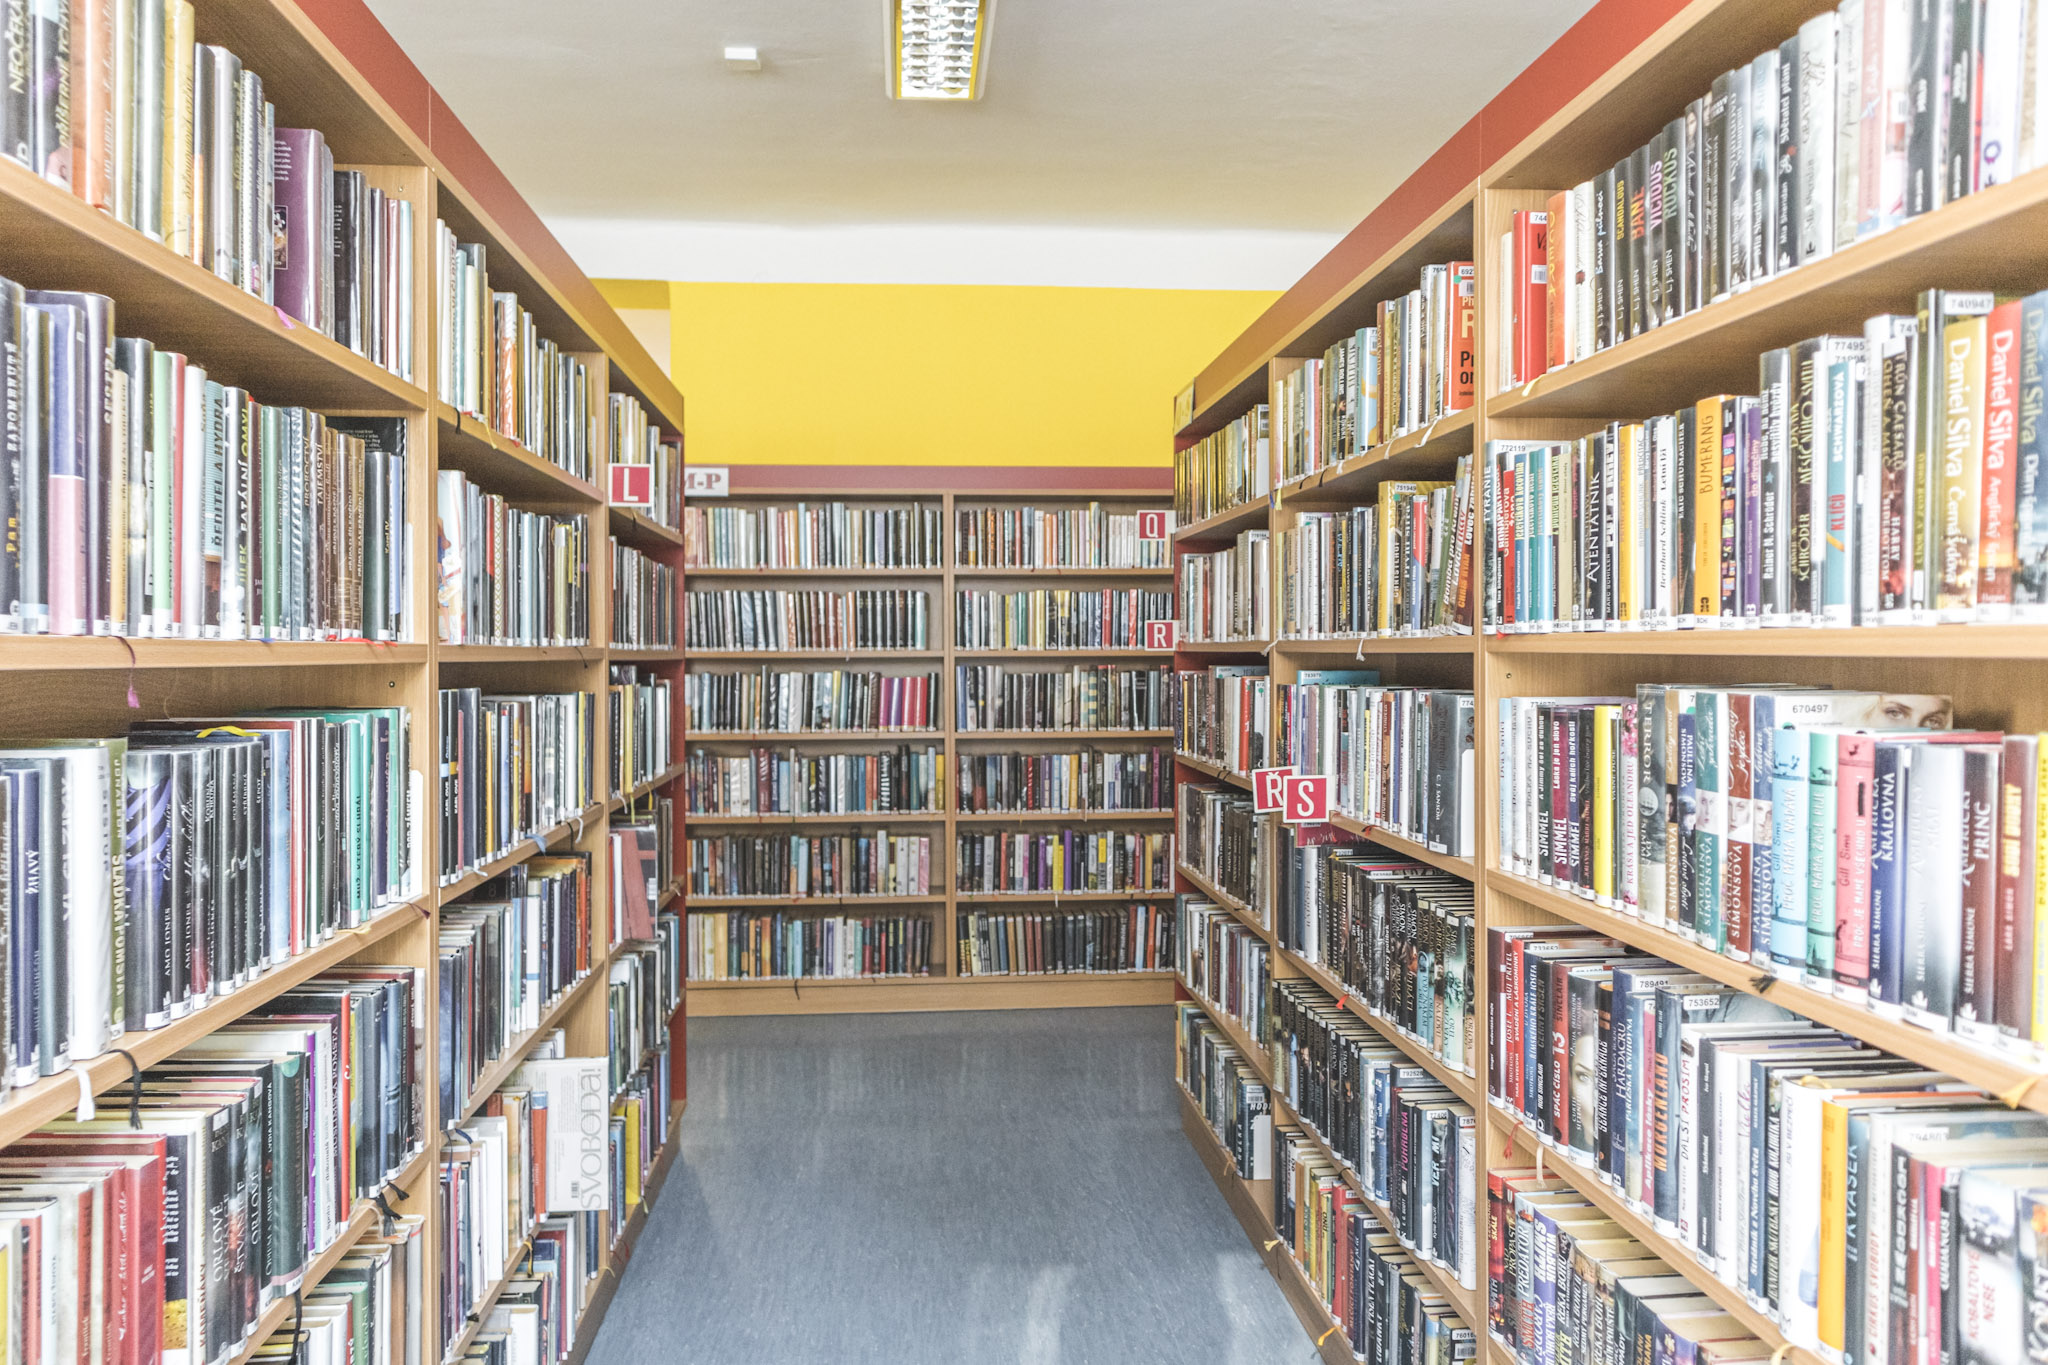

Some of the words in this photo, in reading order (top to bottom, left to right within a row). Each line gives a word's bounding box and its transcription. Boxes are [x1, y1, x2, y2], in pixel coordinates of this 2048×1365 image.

[1649, 160, 1663, 231] VICIOUS
[1663, 147, 1678, 221] RUCKUS
[1780, 181, 1789, 224] Sheridan
[1615, 179, 1625, 241] SCANDALOUS
[1631, 186, 1645, 241] BANE
[1753, 188, 1763, 234] Sheridan
[1632, 269, 1640, 295] SHEN
[1651, 259, 1659, 286] SHEN
[1665, 248, 1673, 276] SHEN
[1616, 278, 1624, 304] SHEN
[1988, 328, 2014, 408] Daniel
[2024, 309, 2044, 384] Daniel
[1946, 335, 1972, 415] Daniel
[2020, 385, 2043, 445] Silva
[1698, 414, 1715, 495] BUMERANG
[1945, 417, 1972, 478] Silva
[1986, 408, 2013, 470] Silva
[314, 442, 324, 506] TAJEMSTVÍ
[623, 467, 639, 502] L
[1483, 465, 1492, 523] TYRANIE
[1145, 512, 1159, 538] Q
[1659, 498, 1668, 537] Schlink
[1890, 517, 1901, 561] HARRY
[1659, 539, 1668, 589] Bernhard
[1763, 548, 1775, 580] Rainer
[1152, 623, 1167, 649] R
[1790, 703, 1829, 714] 670497
[1642, 701, 1654, 785] TERROR
[1296, 779, 1315, 817] S
[1625, 760, 1634, 816] OLEANDRU
[1538, 810, 1550, 857] SIMMEL
[1880, 772, 1895, 862] KRÁLOVNA
[1973, 801, 1991, 860] PRINC
[1553, 817, 1568, 865] SIMMEL
[164, 907, 172, 945] JONES
[185, 902, 193, 939] JONES
[1872, 888, 1883, 931] SIMONE
[164, 948, 172, 977] AMO
[1871, 933, 1881, 970] SIERRA
[1964, 954, 1975, 995] SIERRA
[1643, 1127, 1654, 1190] Aplikace
[1517, 1225, 1530, 1297] PREDATOR
[1533, 1218, 1547, 1284] SMITH
[1982, 1283, 1996, 1323] NEBE
